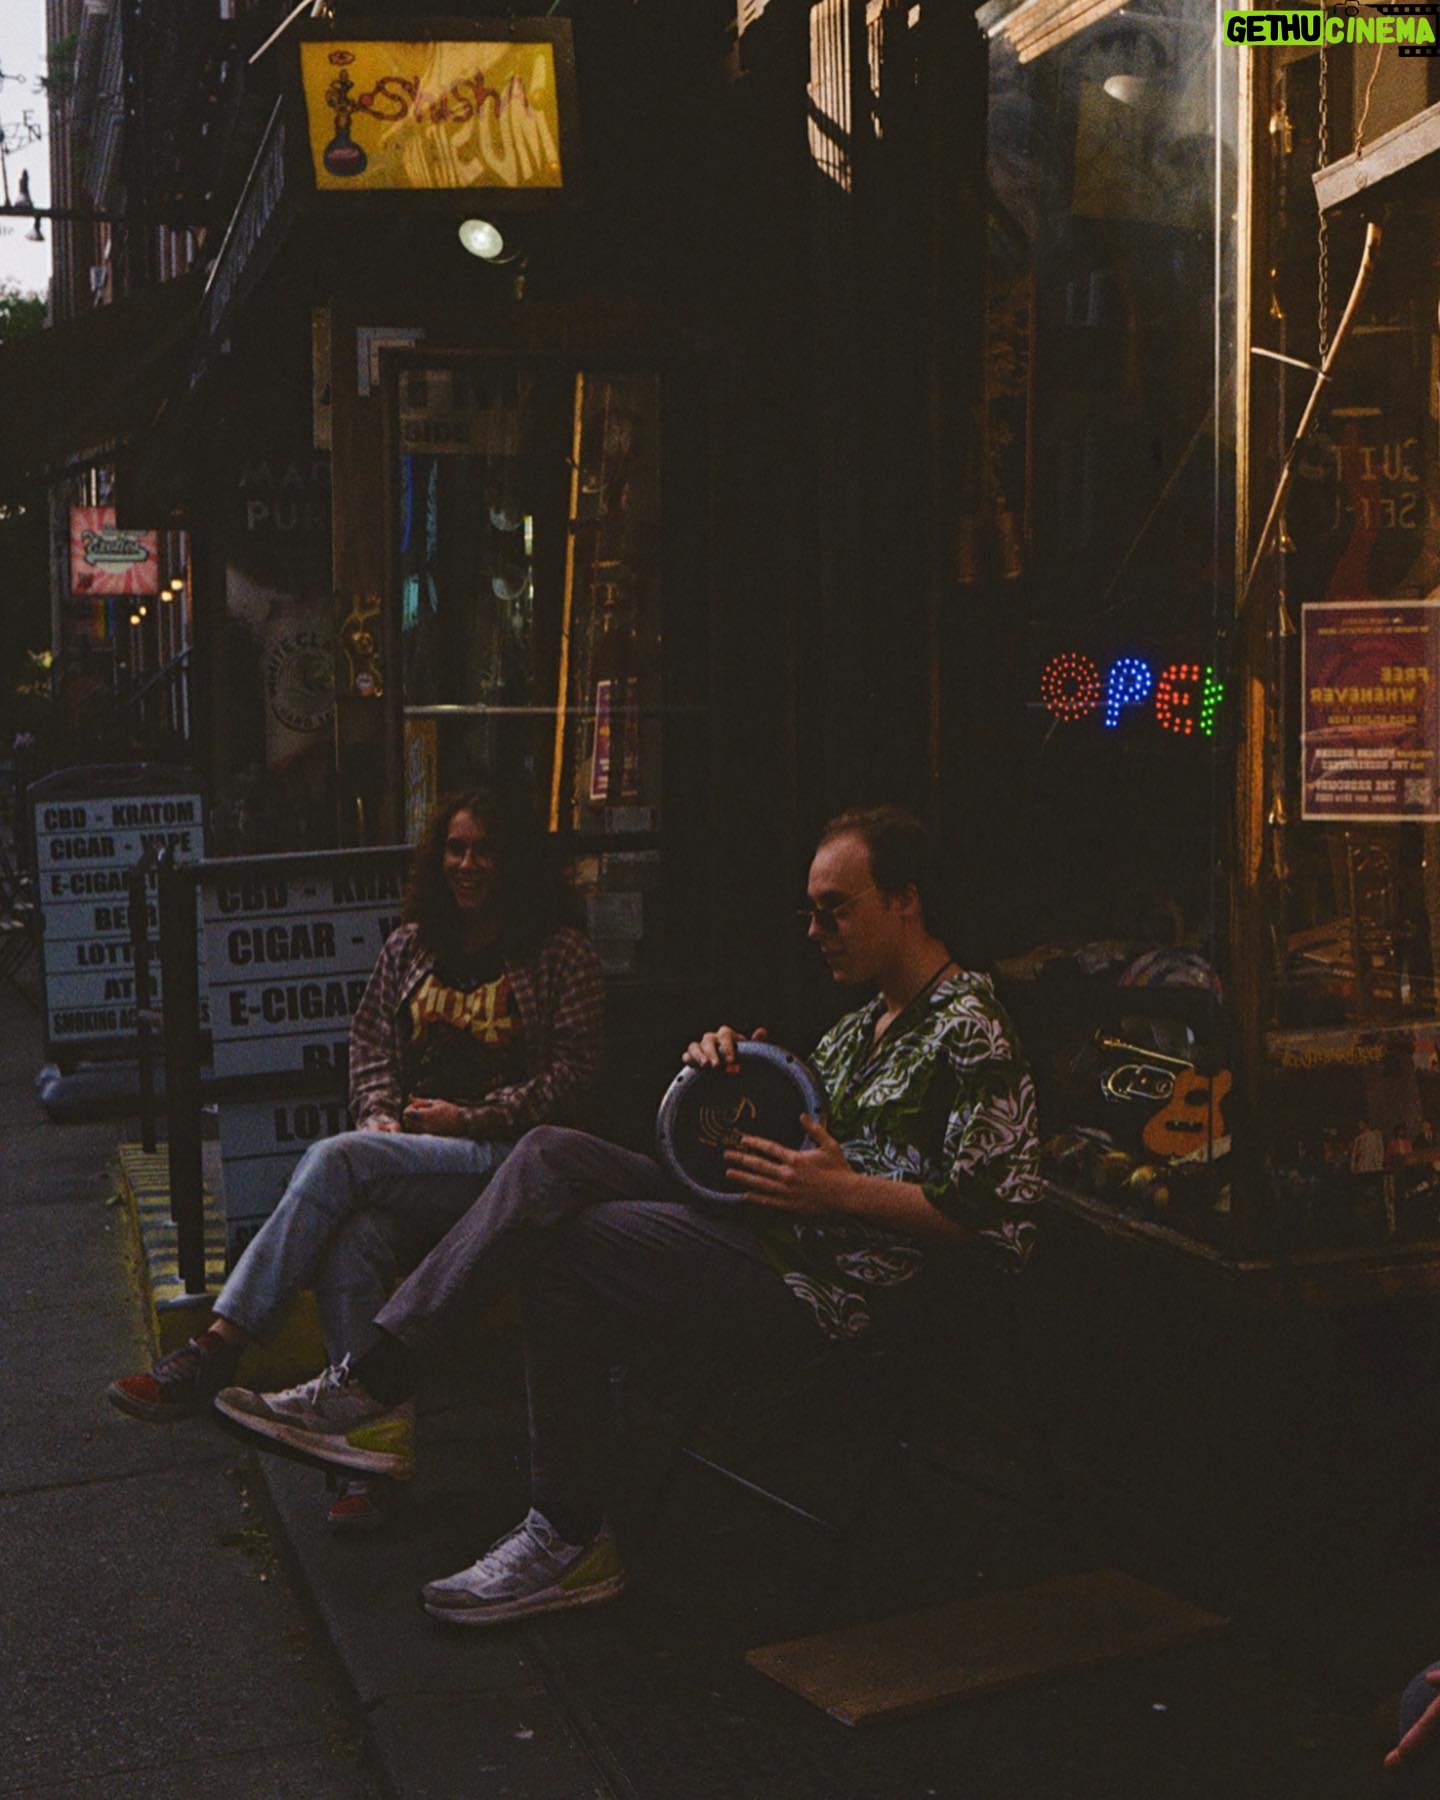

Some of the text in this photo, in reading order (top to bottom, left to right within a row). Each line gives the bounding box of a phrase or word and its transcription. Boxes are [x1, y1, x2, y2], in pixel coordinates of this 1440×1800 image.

[43, 807, 86, 831] CBD
[111, 801, 194, 826] KRATOM
[50, 836, 114, 861] CIGAR
[94, 904, 158, 931] BER
[227, 921, 336, 966] CIGAR
